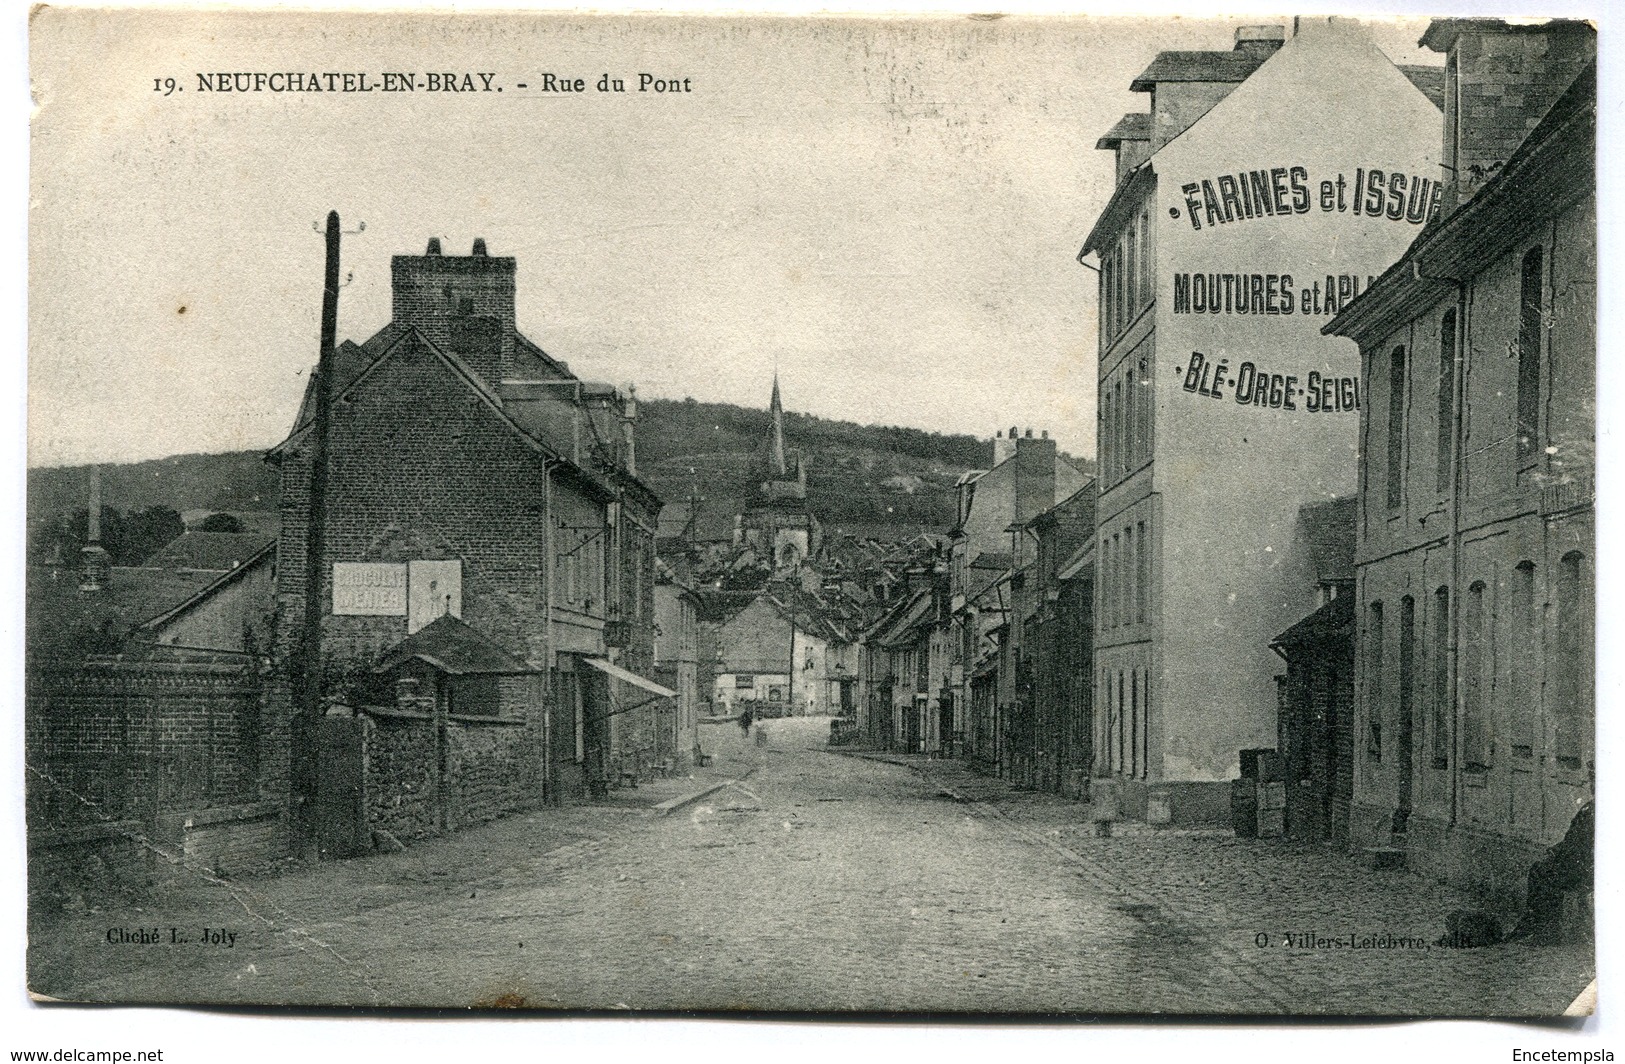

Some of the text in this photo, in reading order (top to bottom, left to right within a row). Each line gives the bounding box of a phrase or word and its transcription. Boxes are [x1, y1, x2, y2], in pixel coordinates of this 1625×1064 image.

[1181, 166, 1311, 230] FARINES
[1319, 173, 1348, 213] et
[1173, 273, 1295, 315] MOUTURES
[1301, 281, 1321, 315] et
